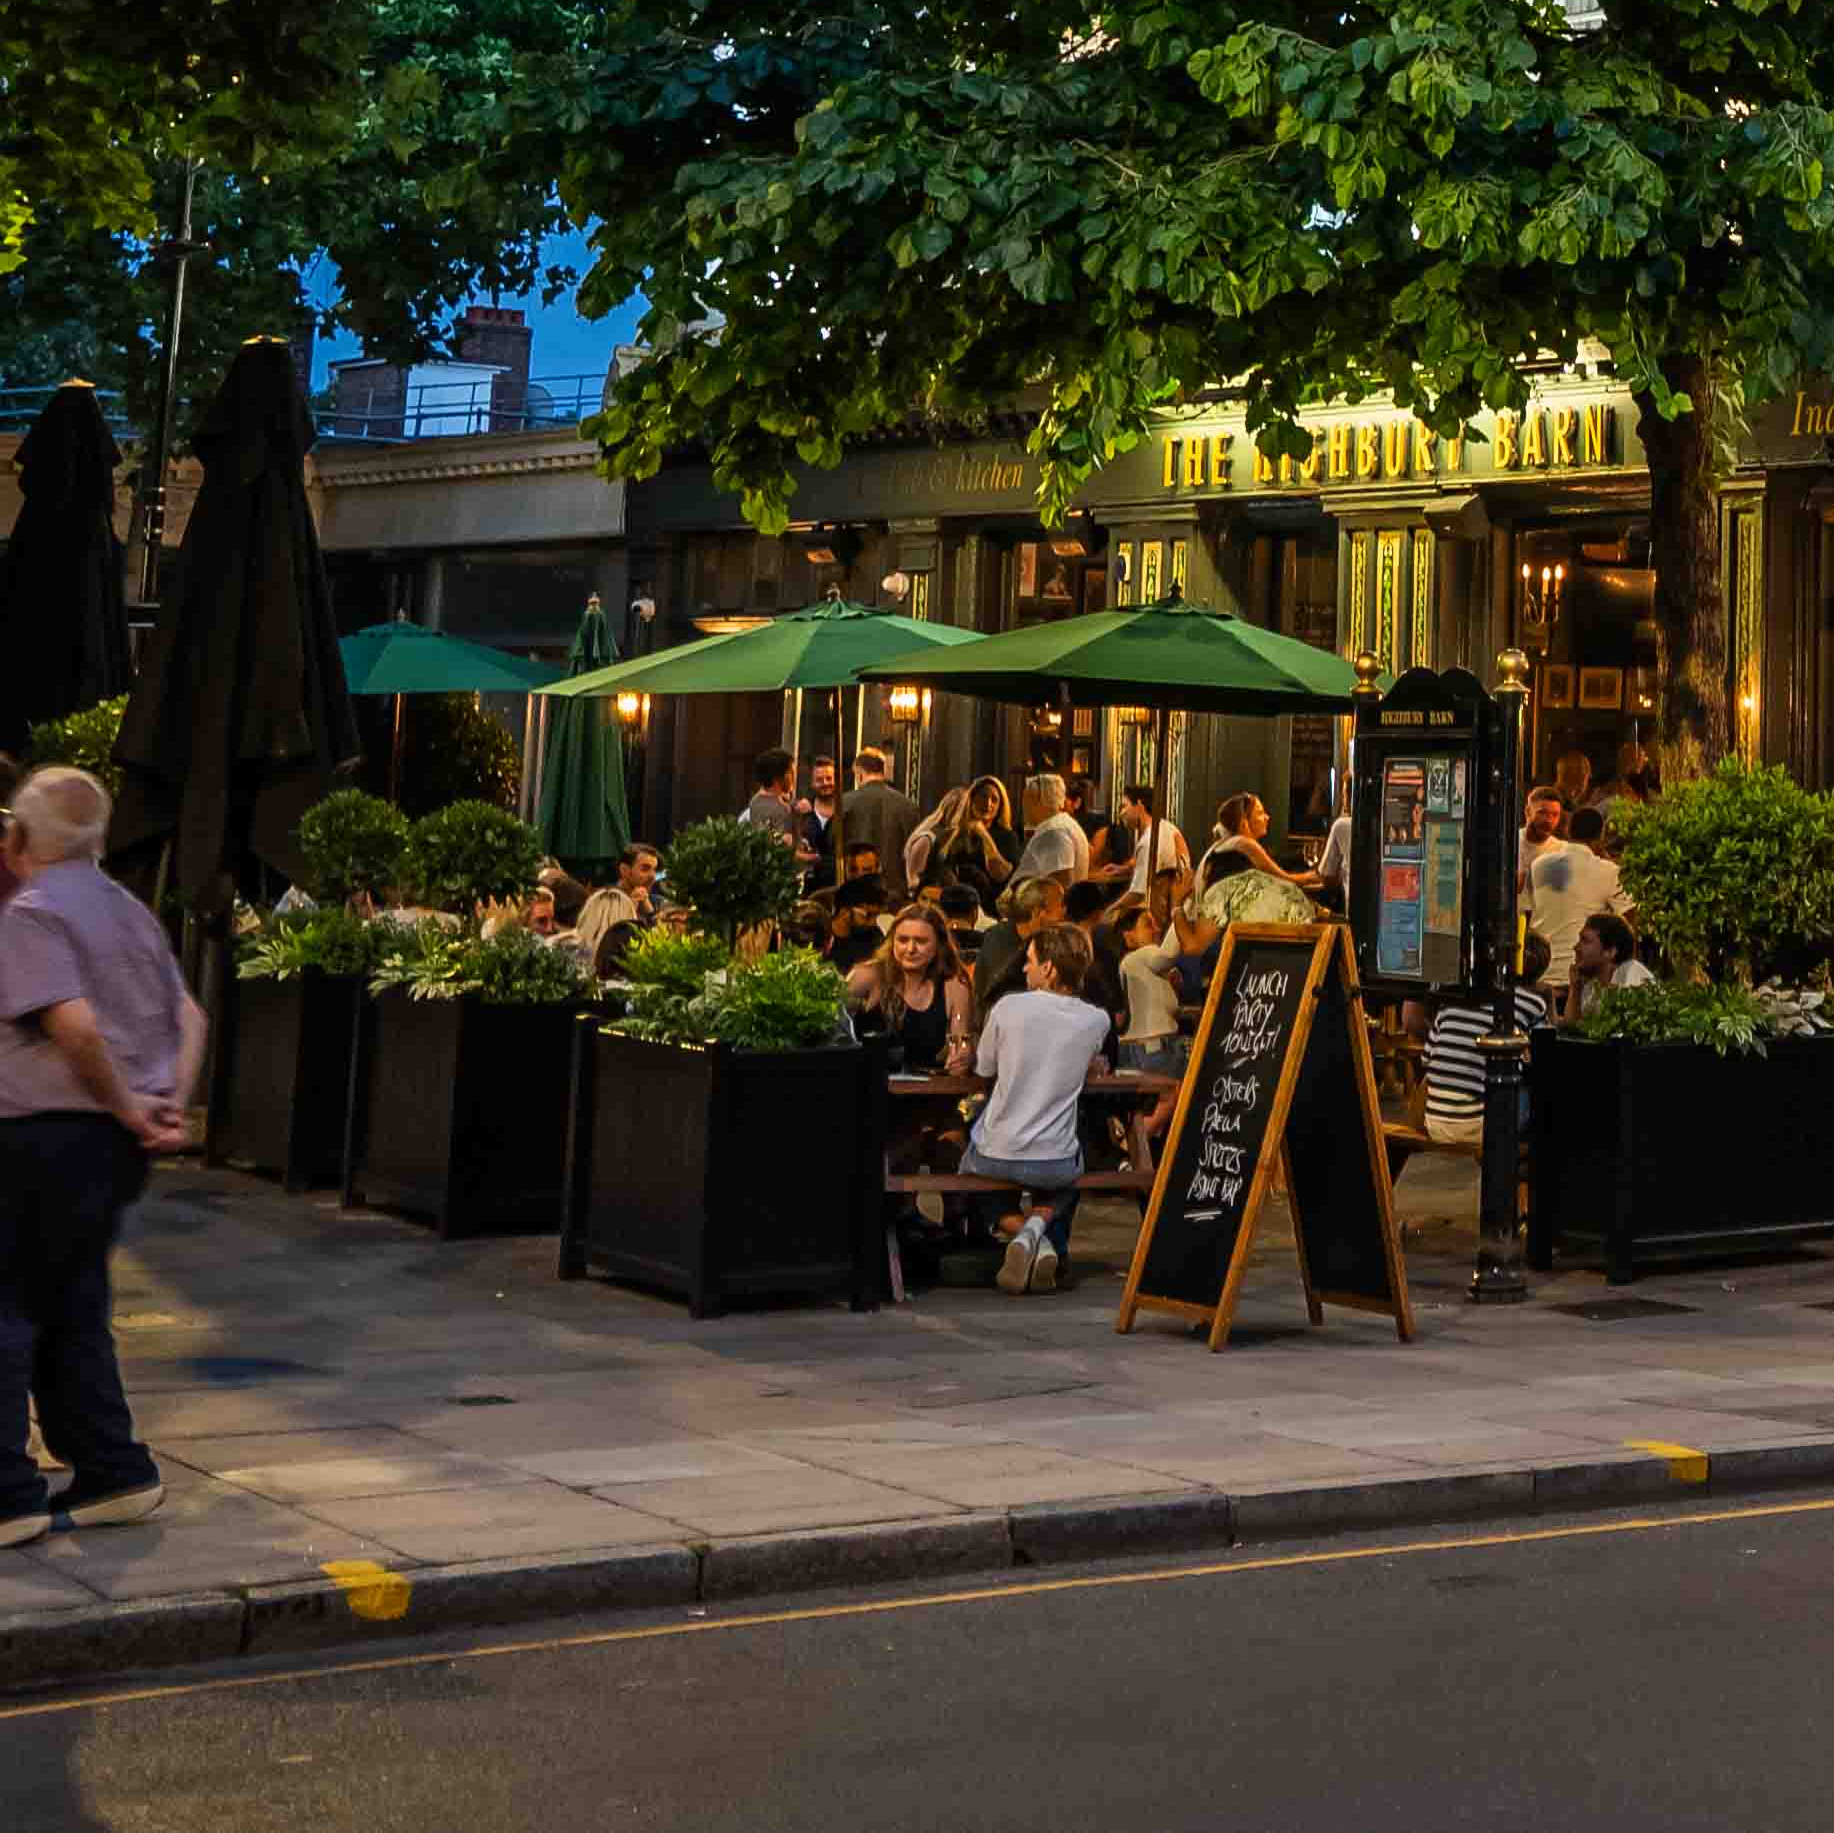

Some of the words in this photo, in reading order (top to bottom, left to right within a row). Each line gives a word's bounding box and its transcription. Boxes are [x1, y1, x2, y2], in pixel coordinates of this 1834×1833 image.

[1163, 433, 1233, 488] THE
[1494, 405, 1608, 469] BARN
[1235, 962, 1289, 998] LAUNCH
[1232, 997, 1275, 1034] PARTY
